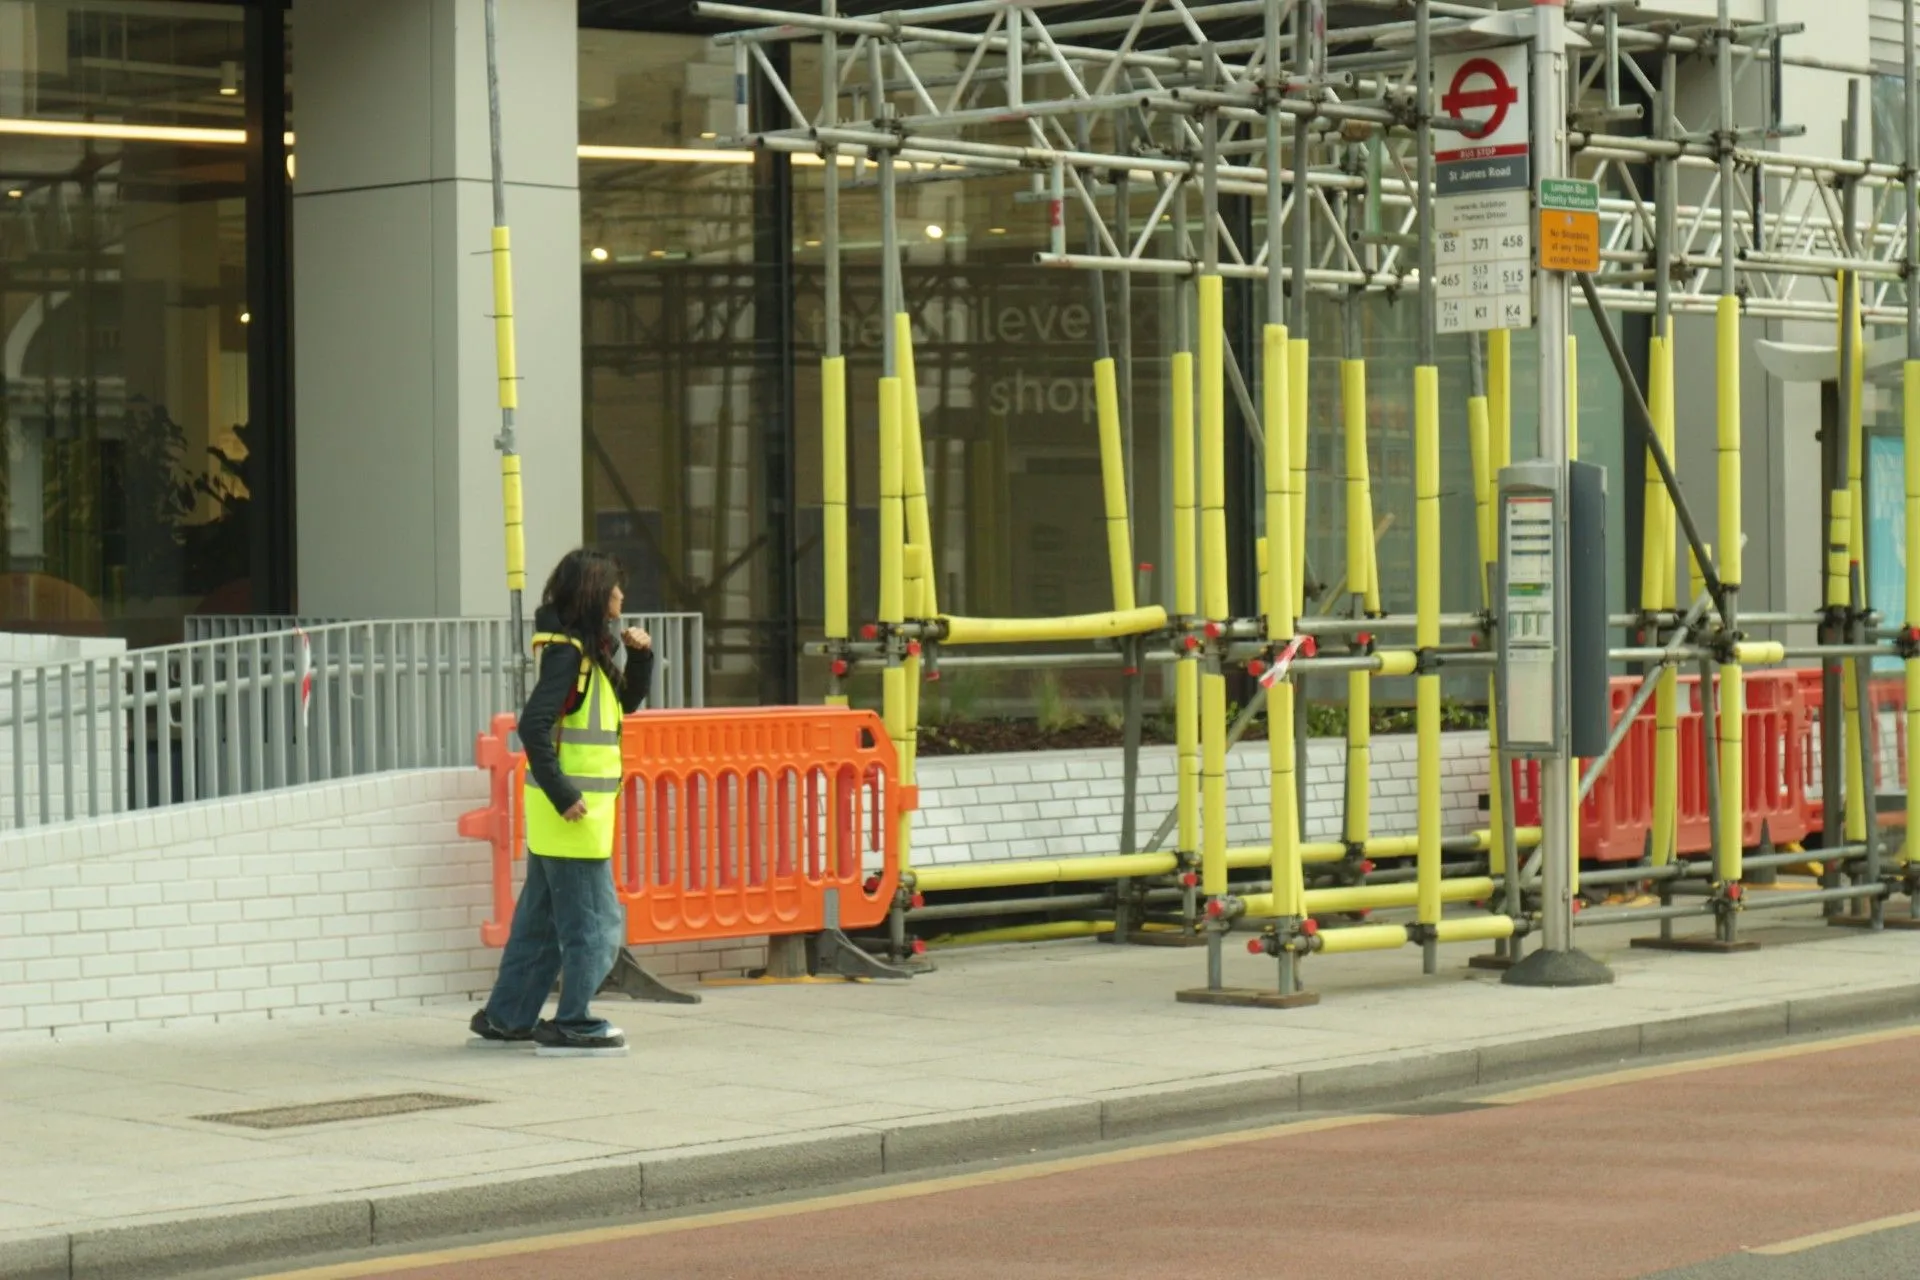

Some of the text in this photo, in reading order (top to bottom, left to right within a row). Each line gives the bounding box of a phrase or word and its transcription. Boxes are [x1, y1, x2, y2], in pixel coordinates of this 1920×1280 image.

[1460, 146, 1497, 159] BUS STOP
[1449, 166, 1512, 181] St James Road
[1444, 240, 1456, 253] 85
[1472, 236, 1489, 251] 371
[1502, 234, 1524, 248] 458
[1441, 273, 1460, 287] 465
[1502, 268, 1524, 283] 515
[1475, 306, 1488, 318] K1
[1505, 303, 1521, 317] K4
